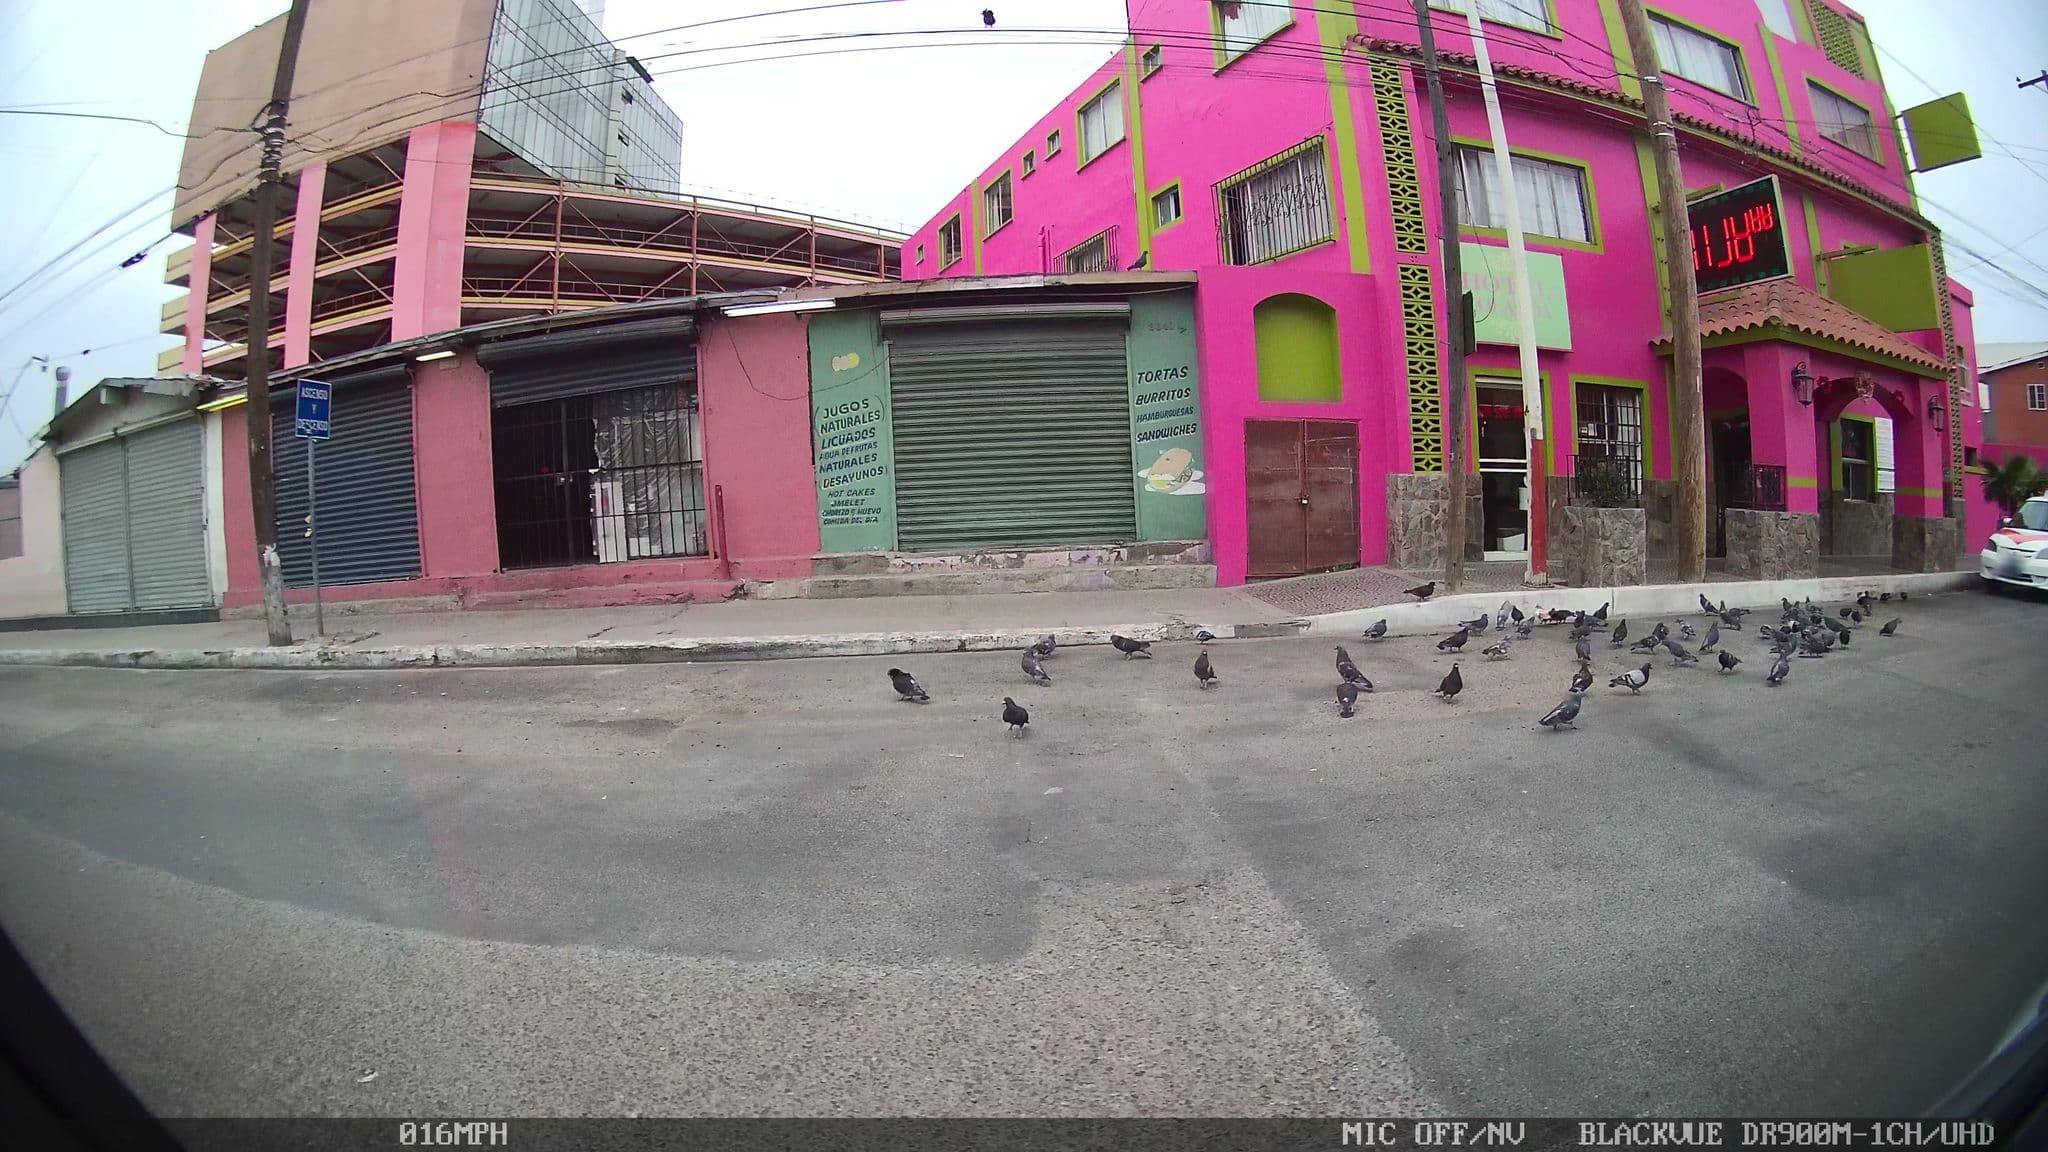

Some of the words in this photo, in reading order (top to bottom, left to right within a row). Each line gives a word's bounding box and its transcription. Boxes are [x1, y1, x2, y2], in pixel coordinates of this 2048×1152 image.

[1137, 366, 1188, 384] TORTAS
[1135, 387, 1191, 406] BURRITOS
[823, 399, 869, 419] JUGOS
[1136, 406, 1194, 423] HAMBURGUESAS
[820, 410, 881, 435] NATURALES
[821, 427, 876, 449] LICUADOS
[1136, 423, 1197, 443] SANDWICHES
[819, 453, 878, 473] NATURALES
[823, 466, 884, 489] DESAYUNOS
[827, 490, 844, 498] HOT
[846, 488, 876, 497] CAKES
